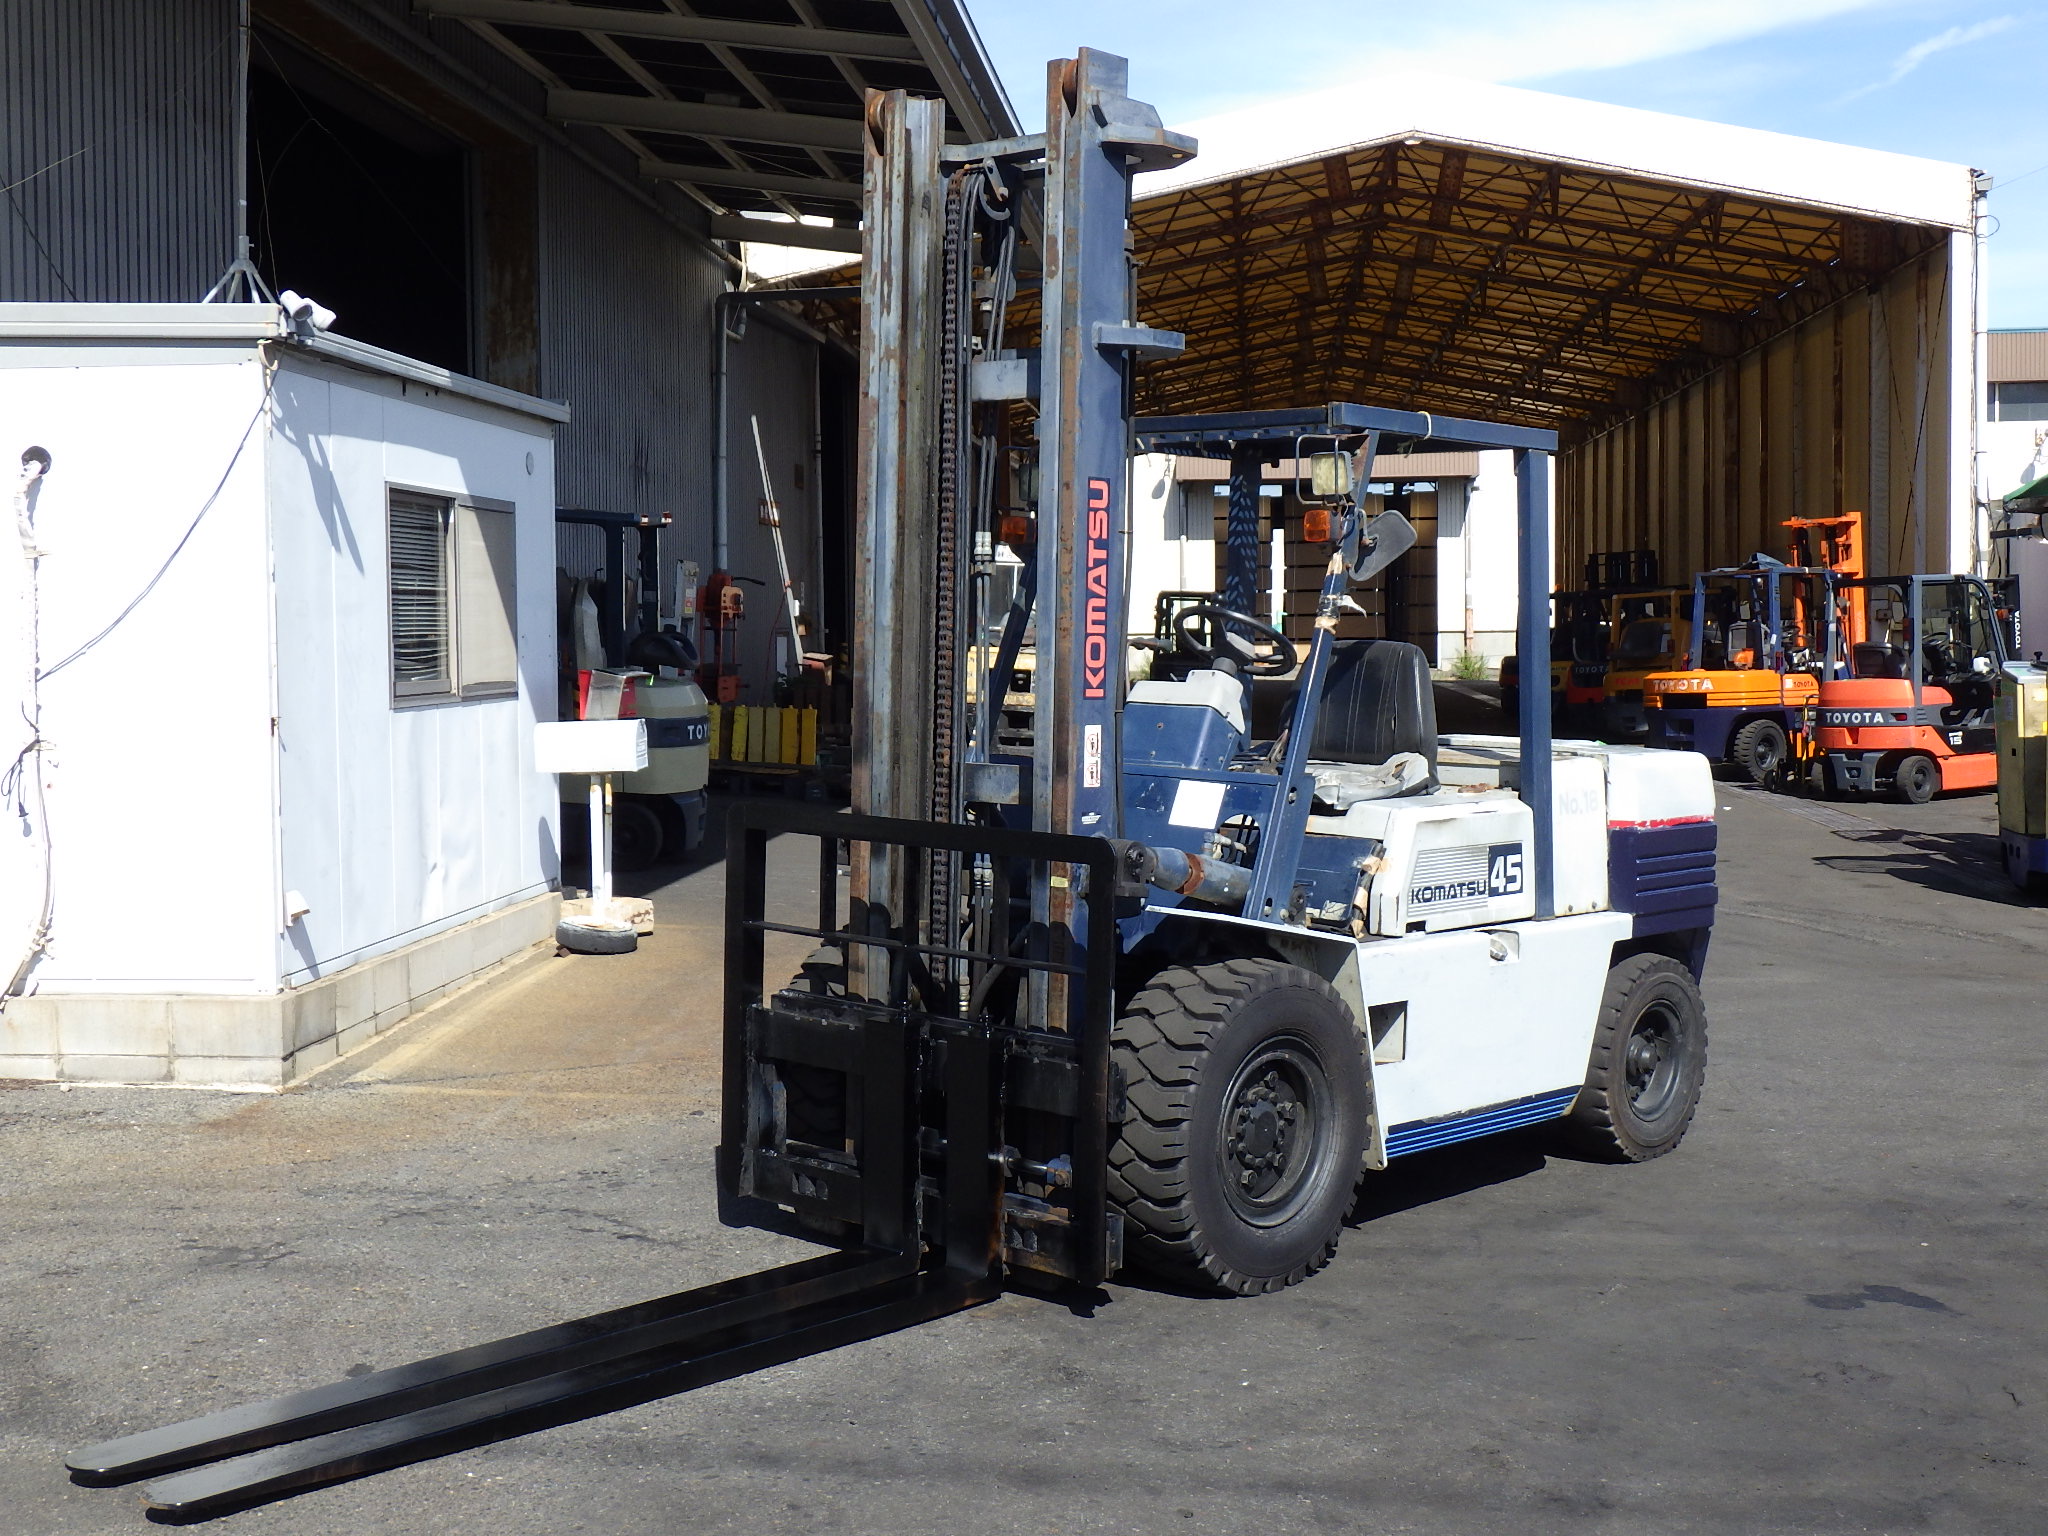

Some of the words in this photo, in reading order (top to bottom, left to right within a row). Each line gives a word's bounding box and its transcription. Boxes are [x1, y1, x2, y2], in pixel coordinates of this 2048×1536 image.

[1085, 479, 1109, 698] KOMATSU
[1653, 678, 1714, 691] TOYOTA
[1792, 679, 1814, 688] TOYOTA
[1825, 712, 1884, 724] TOYOTA
[687, 723, 709, 740] TOY
[1949, 736, 1963, 745] 15
[1411, 880, 1487, 904] KOMATSU
[1490, 853, 1522, 893] 45
